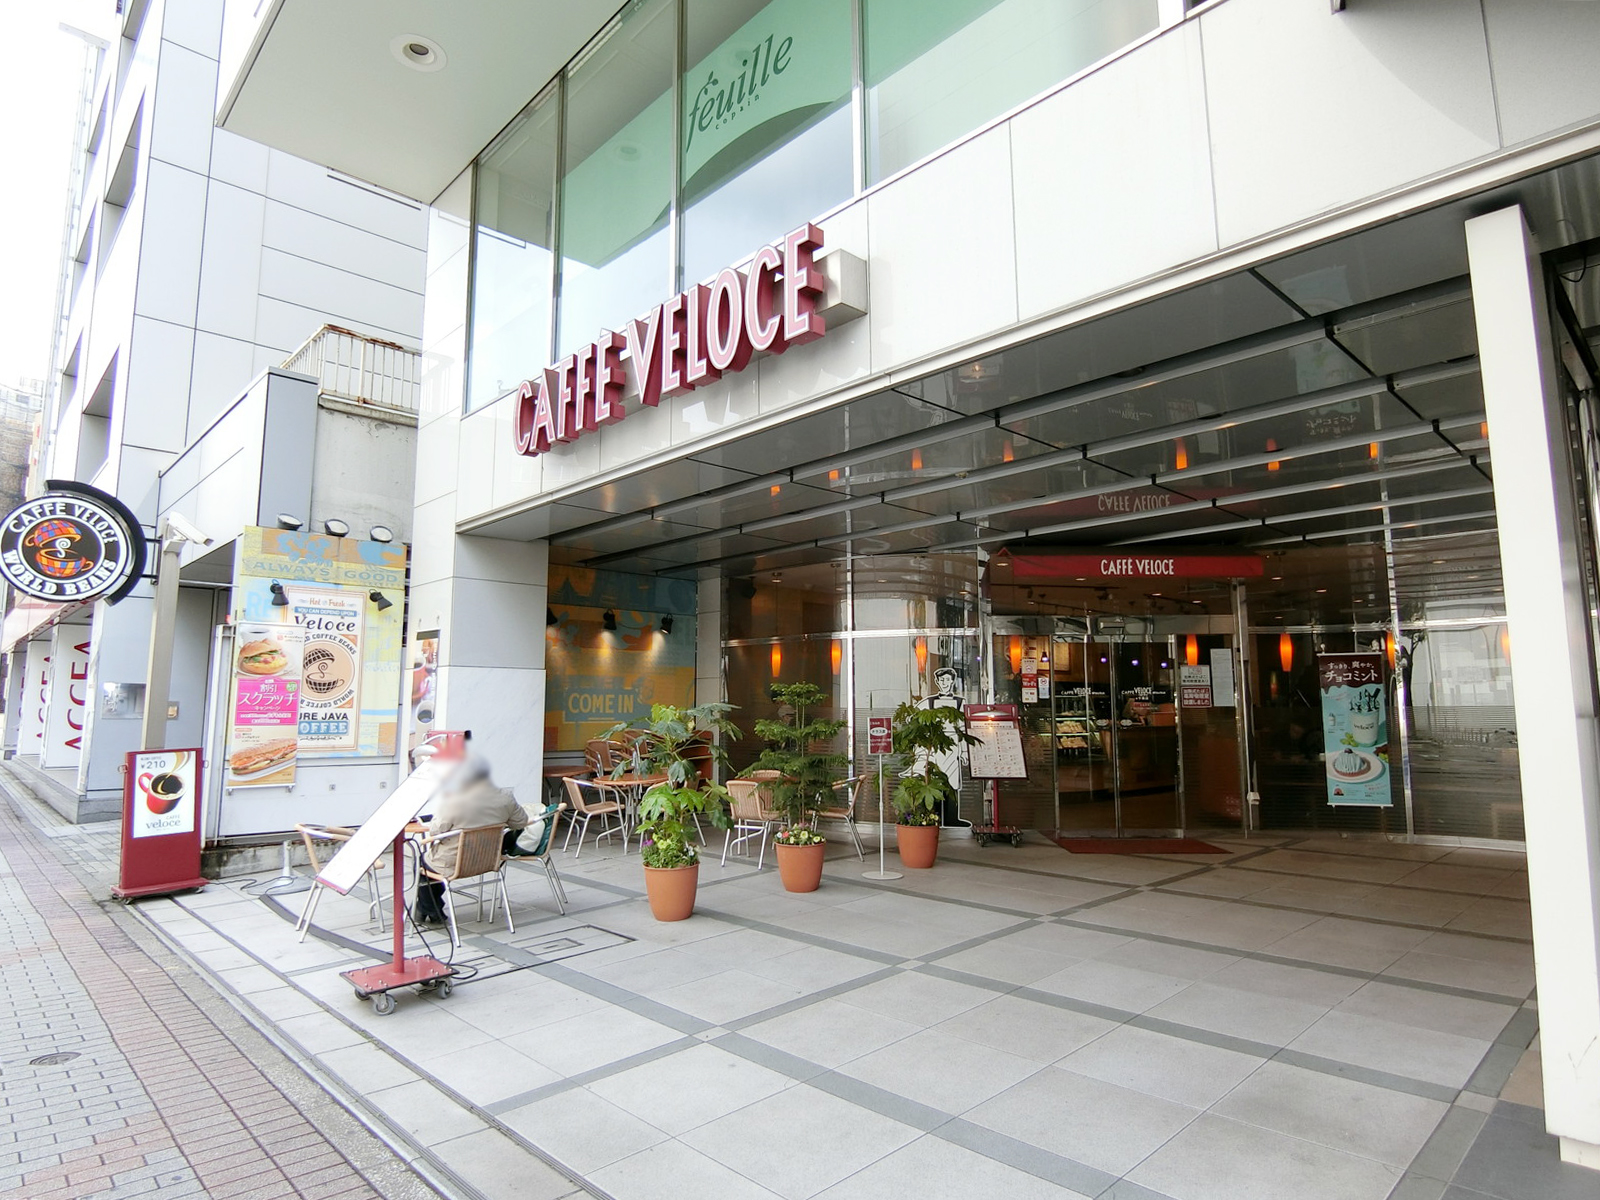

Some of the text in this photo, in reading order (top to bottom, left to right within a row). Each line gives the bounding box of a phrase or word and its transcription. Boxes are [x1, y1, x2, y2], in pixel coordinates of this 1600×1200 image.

[686, 34, 793, 153] feuille
[716, 94, 760, 130] copain
[626, 222, 825, 407] VELOCE
[74, 505, 118, 544] VELOCE
[3, 549, 117, 595] WORLD BEANS
[253, 562, 398, 583] ALWAYS GOOD
[1135, 559, 1174, 575] VELOCE
[294, 615, 356, 632] Veloce
[312, 633, 338, 642] COFFEE
[338, 638, 357, 655] BEANS
[1324, 669, 1378, 683] チョコミント
[260, 684, 278, 693] 割引
[238, 692, 297, 707] スクラッチ
[568, 693, 634, 714] COME IN
[321, 712, 349, 720] JAVA
[146, 819, 181, 829] veloce
